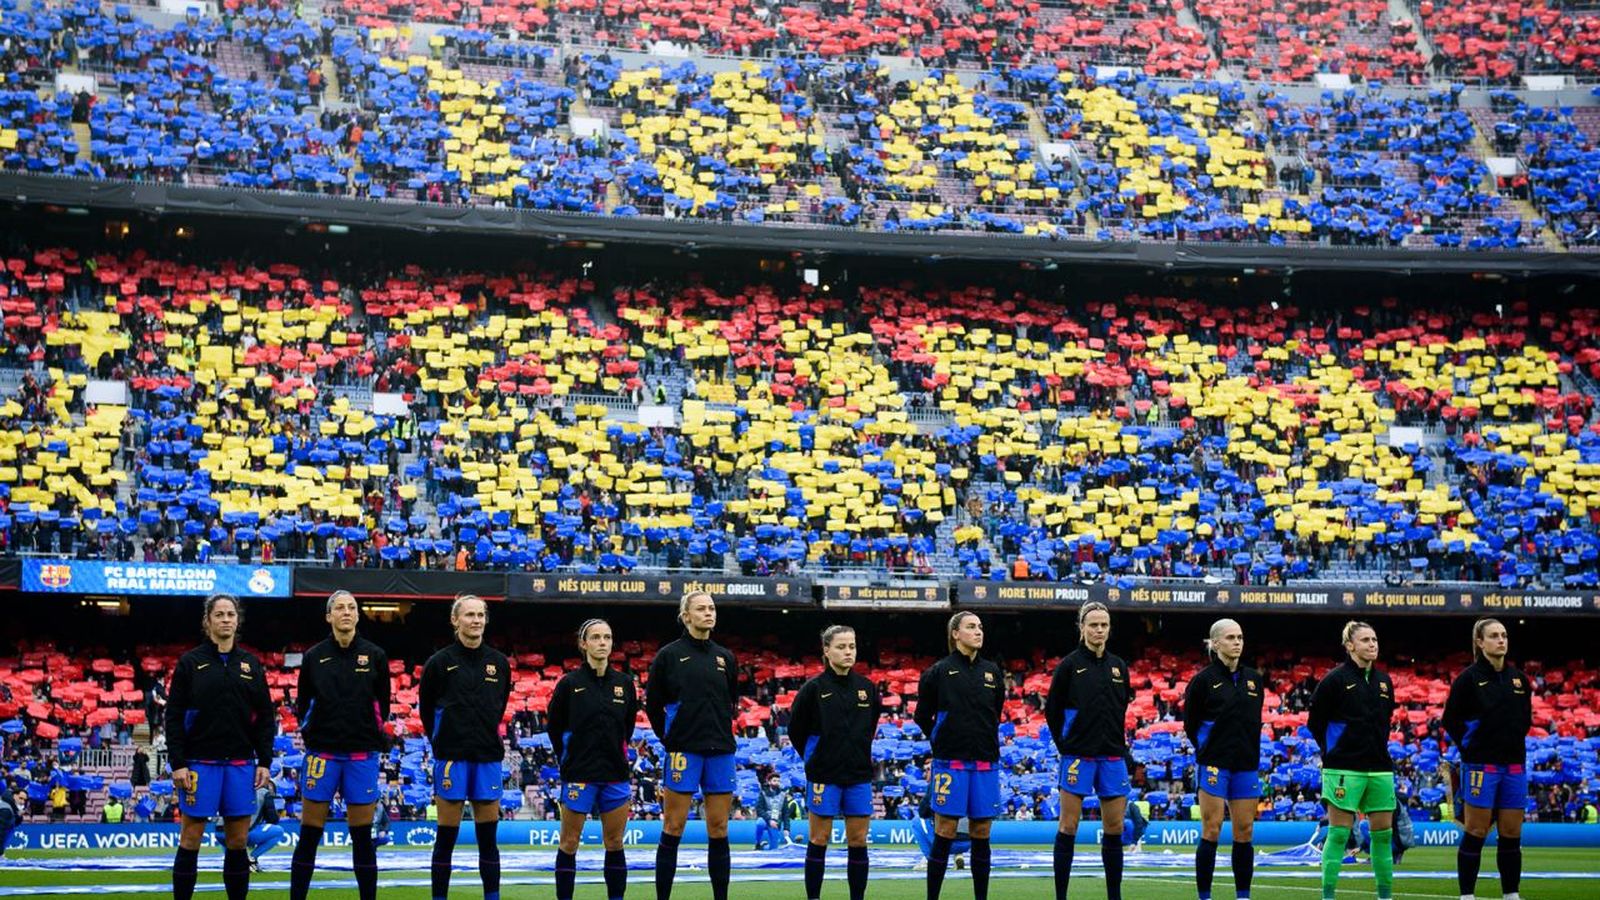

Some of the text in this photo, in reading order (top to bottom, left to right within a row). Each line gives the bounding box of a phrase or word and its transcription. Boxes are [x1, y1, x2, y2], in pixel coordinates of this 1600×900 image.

[104, 566, 217, 580] FC BARCELONA
[107, 577, 215, 591] REAL MADRID
[558, 578, 646, 594] MÉS QUE UN CLUB
[704, 583, 726, 595] QUE
[727, 583, 766, 595] ORGULL
[900, 589, 918, 598] CLUB
[998, 587, 1089, 600] MORE THAN PROUD
[1131, 588, 1207, 603] MÉS QUE TALENT
[1240, 591, 1329, 604] MORE THAN TALENT
[1366, 592, 1446, 607] MÉS QUE UN CLUB
[1483, 593, 1502, 606] MÉS
[1503, 596, 1522, 609] QUE
[1533, 596, 1583, 608] JUGADORS
[306, 755, 326, 779] 10
[669, 752, 687, 771] 16
[934, 773, 952, 795] 12
[1469, 771, 1484, 787] 11
[40, 833, 89, 849] UEFA
[1162, 829, 1199, 844] МИР
[1423, 829, 1460, 846] МИР
